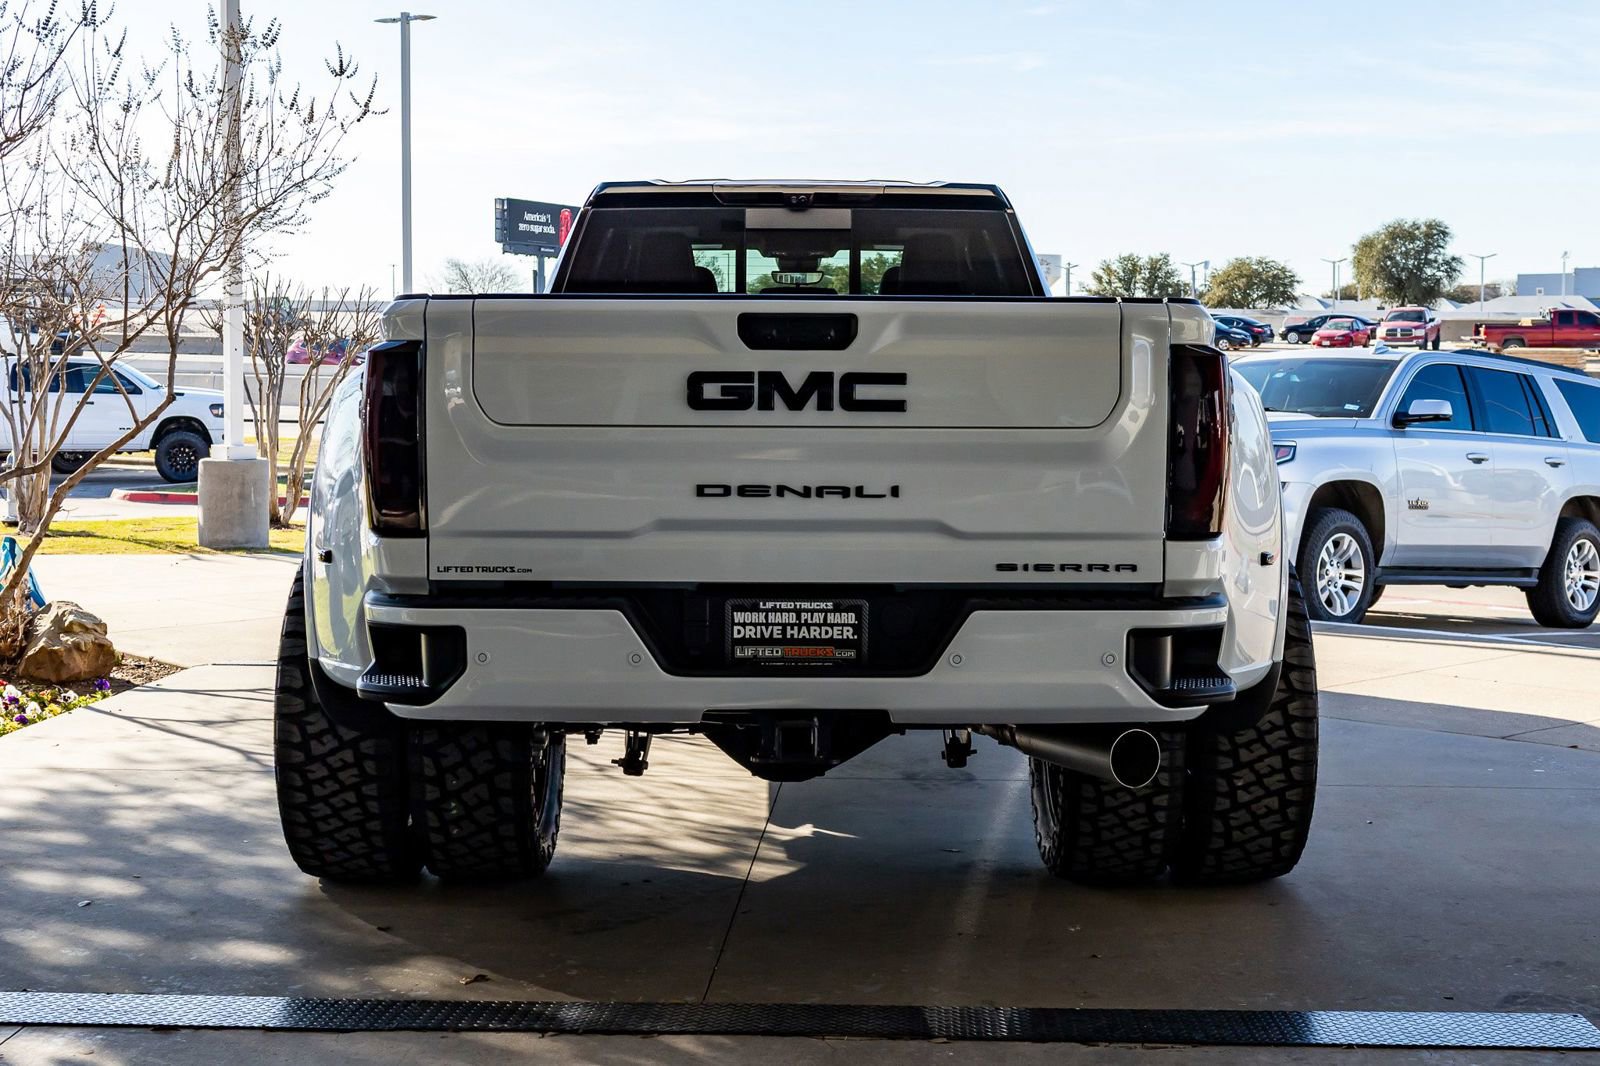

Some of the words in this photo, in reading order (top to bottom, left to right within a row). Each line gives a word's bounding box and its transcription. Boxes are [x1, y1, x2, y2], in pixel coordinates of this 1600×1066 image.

[687, 371, 907, 412] GMC
[696, 484, 900, 499] DENALI
[996, 563, 1137, 572] SIERRA
[734, 612, 766, 624] WORK
[768, 612, 799, 624] HARD.
[801, 612, 825, 624] PLAY
[827, 612, 858, 624] HARD.
[734, 626, 782, 638] DRIVE
[786, 626, 858, 639] HARDER.
[736, 648, 782, 656] LIFTED
